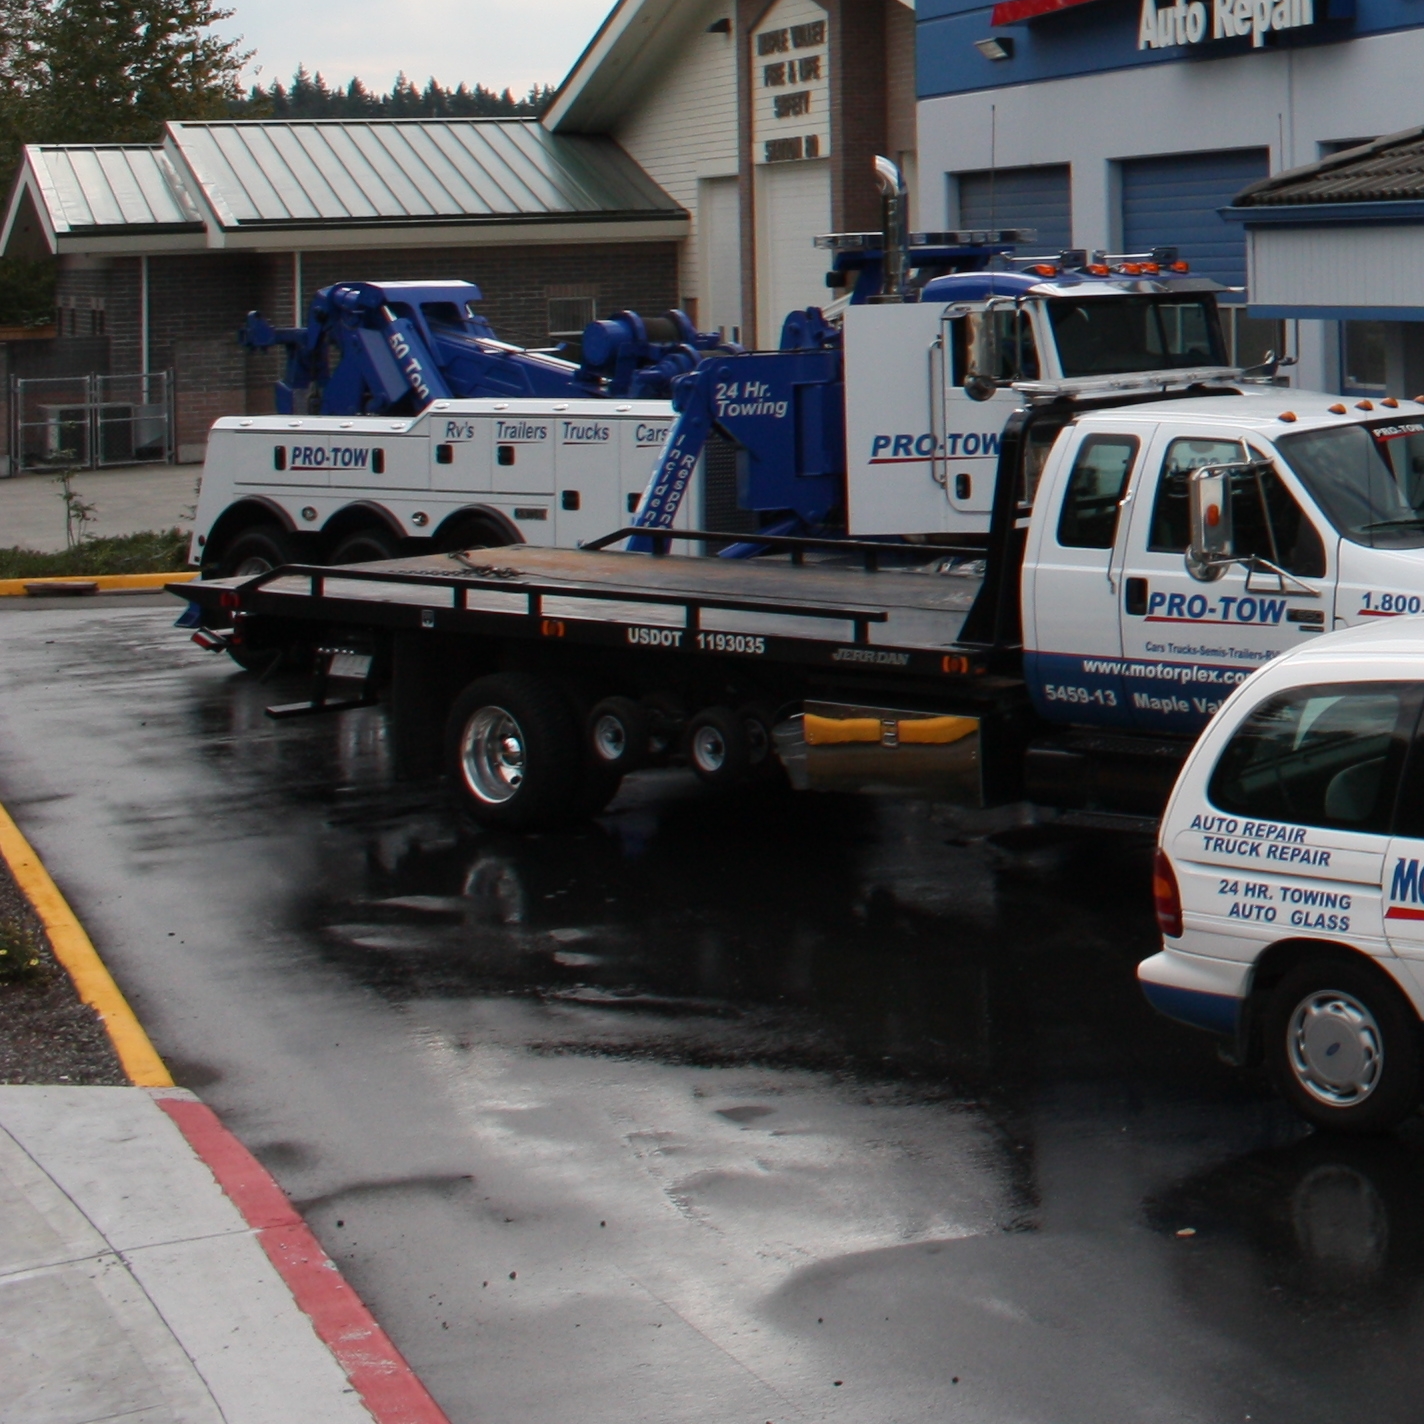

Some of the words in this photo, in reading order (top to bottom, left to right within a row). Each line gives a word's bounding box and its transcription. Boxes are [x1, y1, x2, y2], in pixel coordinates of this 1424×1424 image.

[389, 332, 410, 359] 50
[406, 357, 430, 400] Ton
[716, 382, 739, 400] 24
[744, 381, 771, 398] Hr.
[717, 399, 788, 418] Towing
[445, 421, 475, 440] Rv's
[497, 421, 548, 440] Trailers
[562, 421, 610, 441] Trucks
[636, 424, 669, 442] Cars
[291, 446, 369, 467] PRO-TOW
[871, 433, 1001, 457] PRO-TOW
[1147, 591, 1287, 623] PRO-TOW
[627, 627, 682, 648] USDOT
[696, 632, 765, 655] 1193035
[1145, 641, 1165, 653] Cars
[1083, 660, 1250, 685] www.motorplex.co
[1045, 683, 1118, 707] 5459-13
[1133, 692, 1190, 715] Maple
[1190, 814, 1238, 833] AUTO
[1242, 821, 1307, 843] REPAIR
[1203, 836, 1263, 857] TRUCK
[1266, 844, 1332, 866] REPAIR
[1218, 879, 1240, 896] 24
[1243, 882, 1273, 900] HR.
[1279, 886, 1352, 910] TOWING
[1228, 902, 1277, 922] AUTO
[1290, 910, 1351, 932] GLASS
